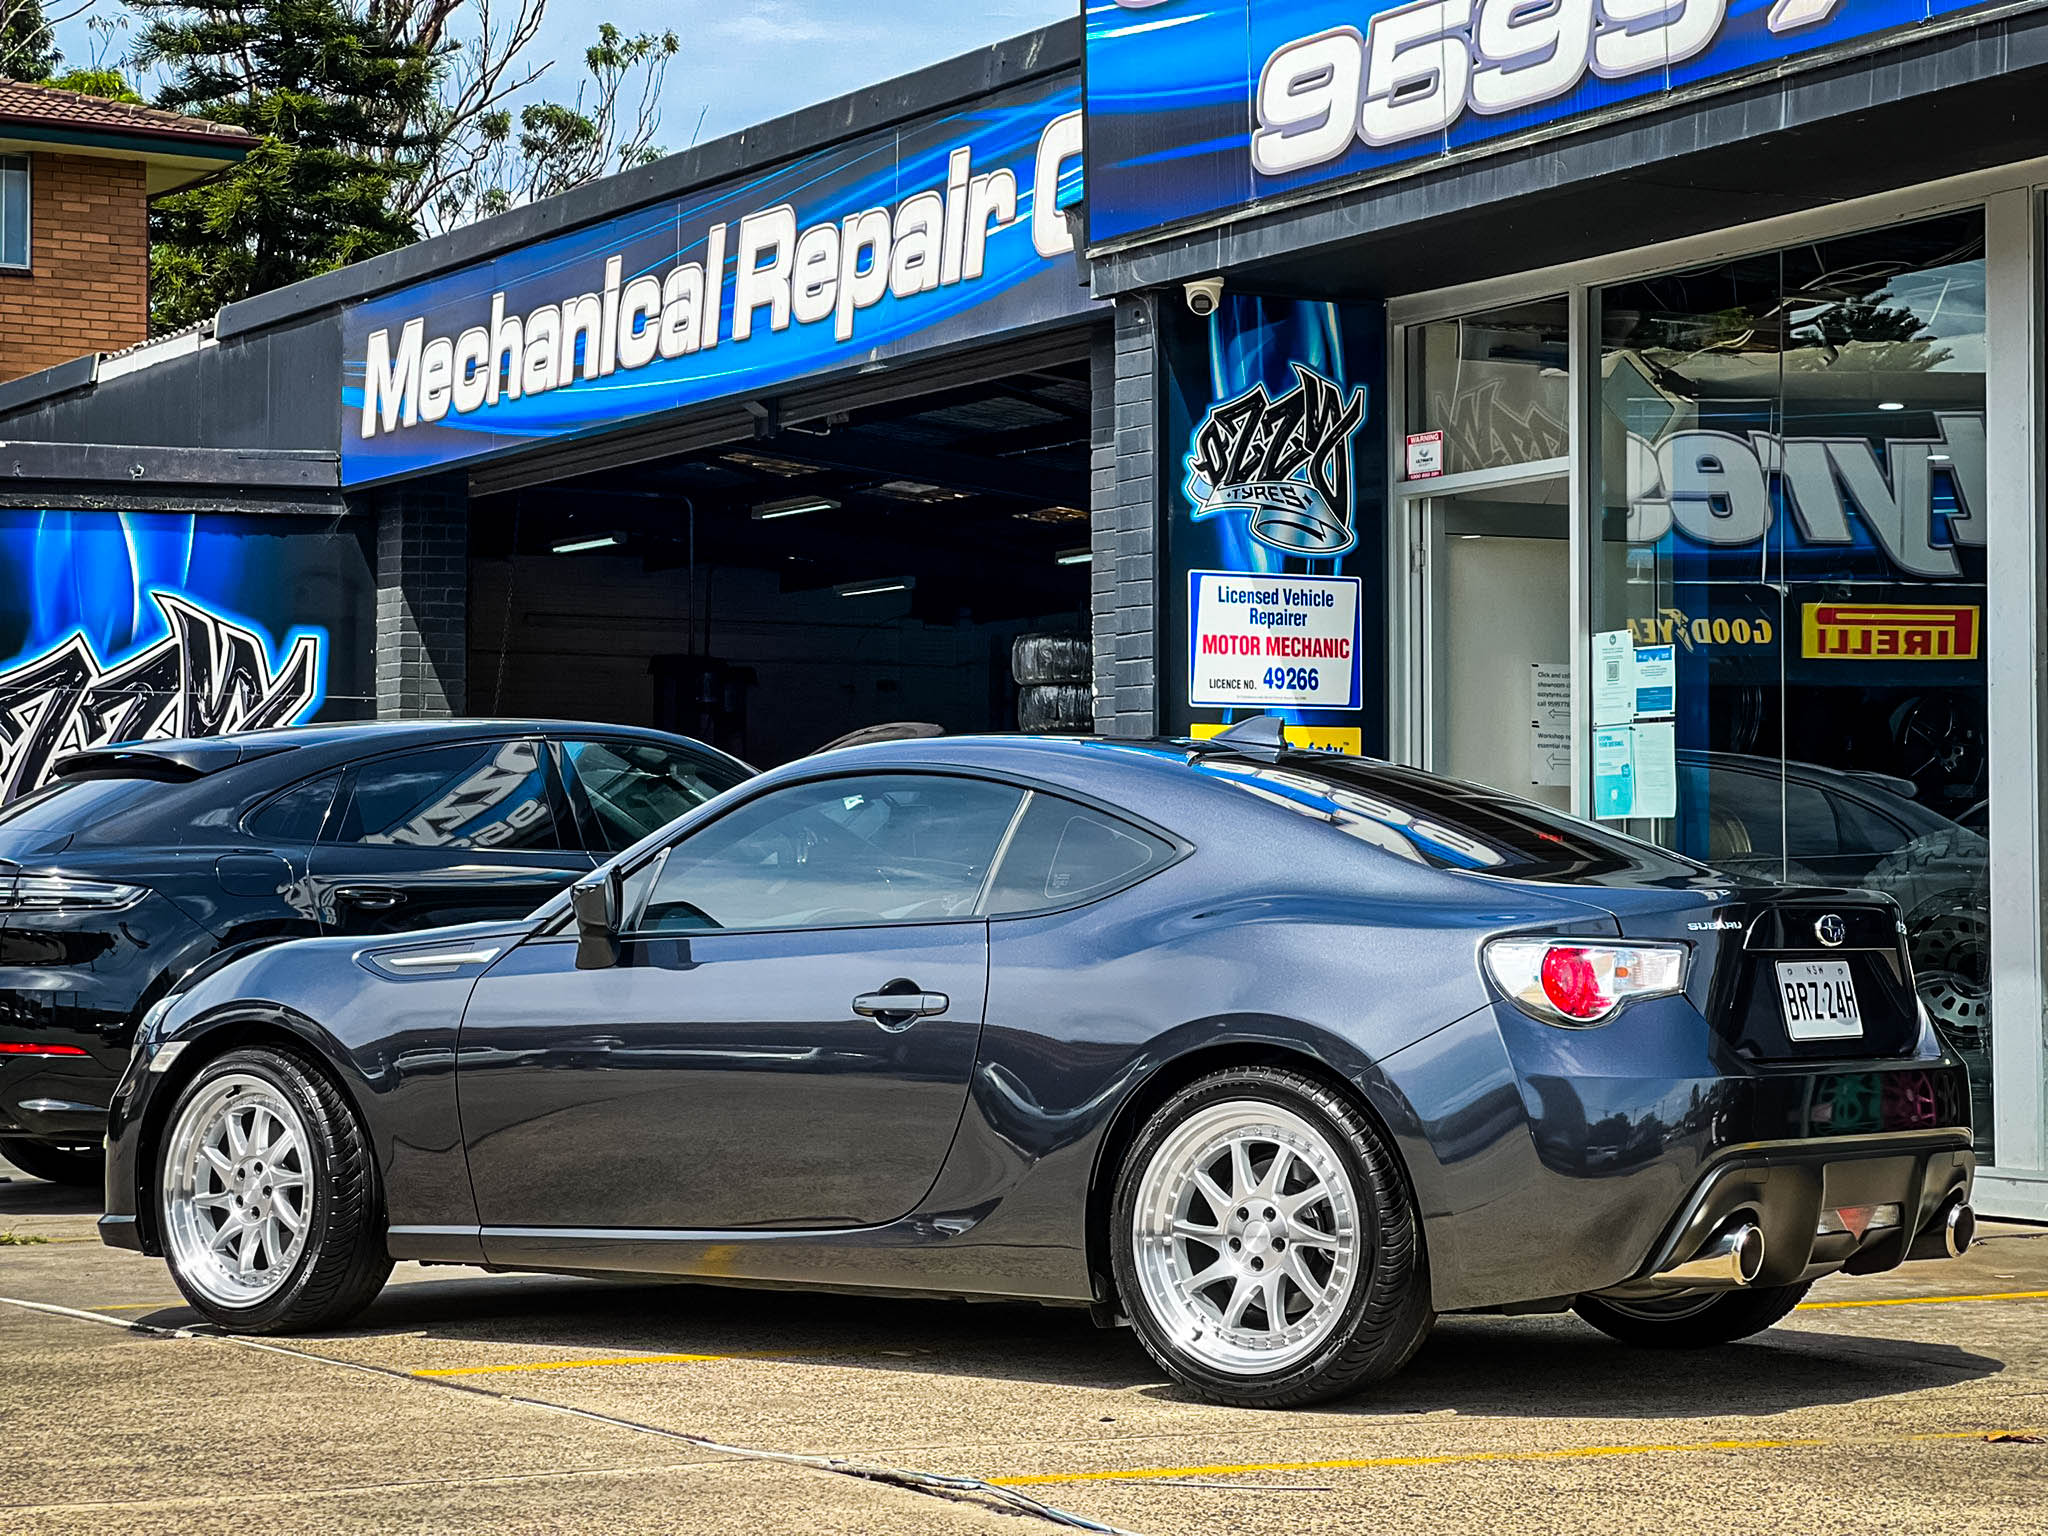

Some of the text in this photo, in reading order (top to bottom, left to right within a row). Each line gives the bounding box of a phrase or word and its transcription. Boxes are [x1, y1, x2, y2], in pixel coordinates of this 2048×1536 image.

[361, 222, 727, 439] Mechanical
[733, 145, 1017, 342] Repair
[1410, 433, 1439, 443] WARNING
[1232, 485, 1308, 511] TYRES
[1218, 585, 1334, 607] Licensed Vehicle
[1250, 607, 1307, 629] Repairer
[1202, 634, 1350, 659] MOTOR MECHANIC
[1209, 667, 1319, 691] LICENCE NO. 49266
[1688, 920, 1742, 930] SUBARU
